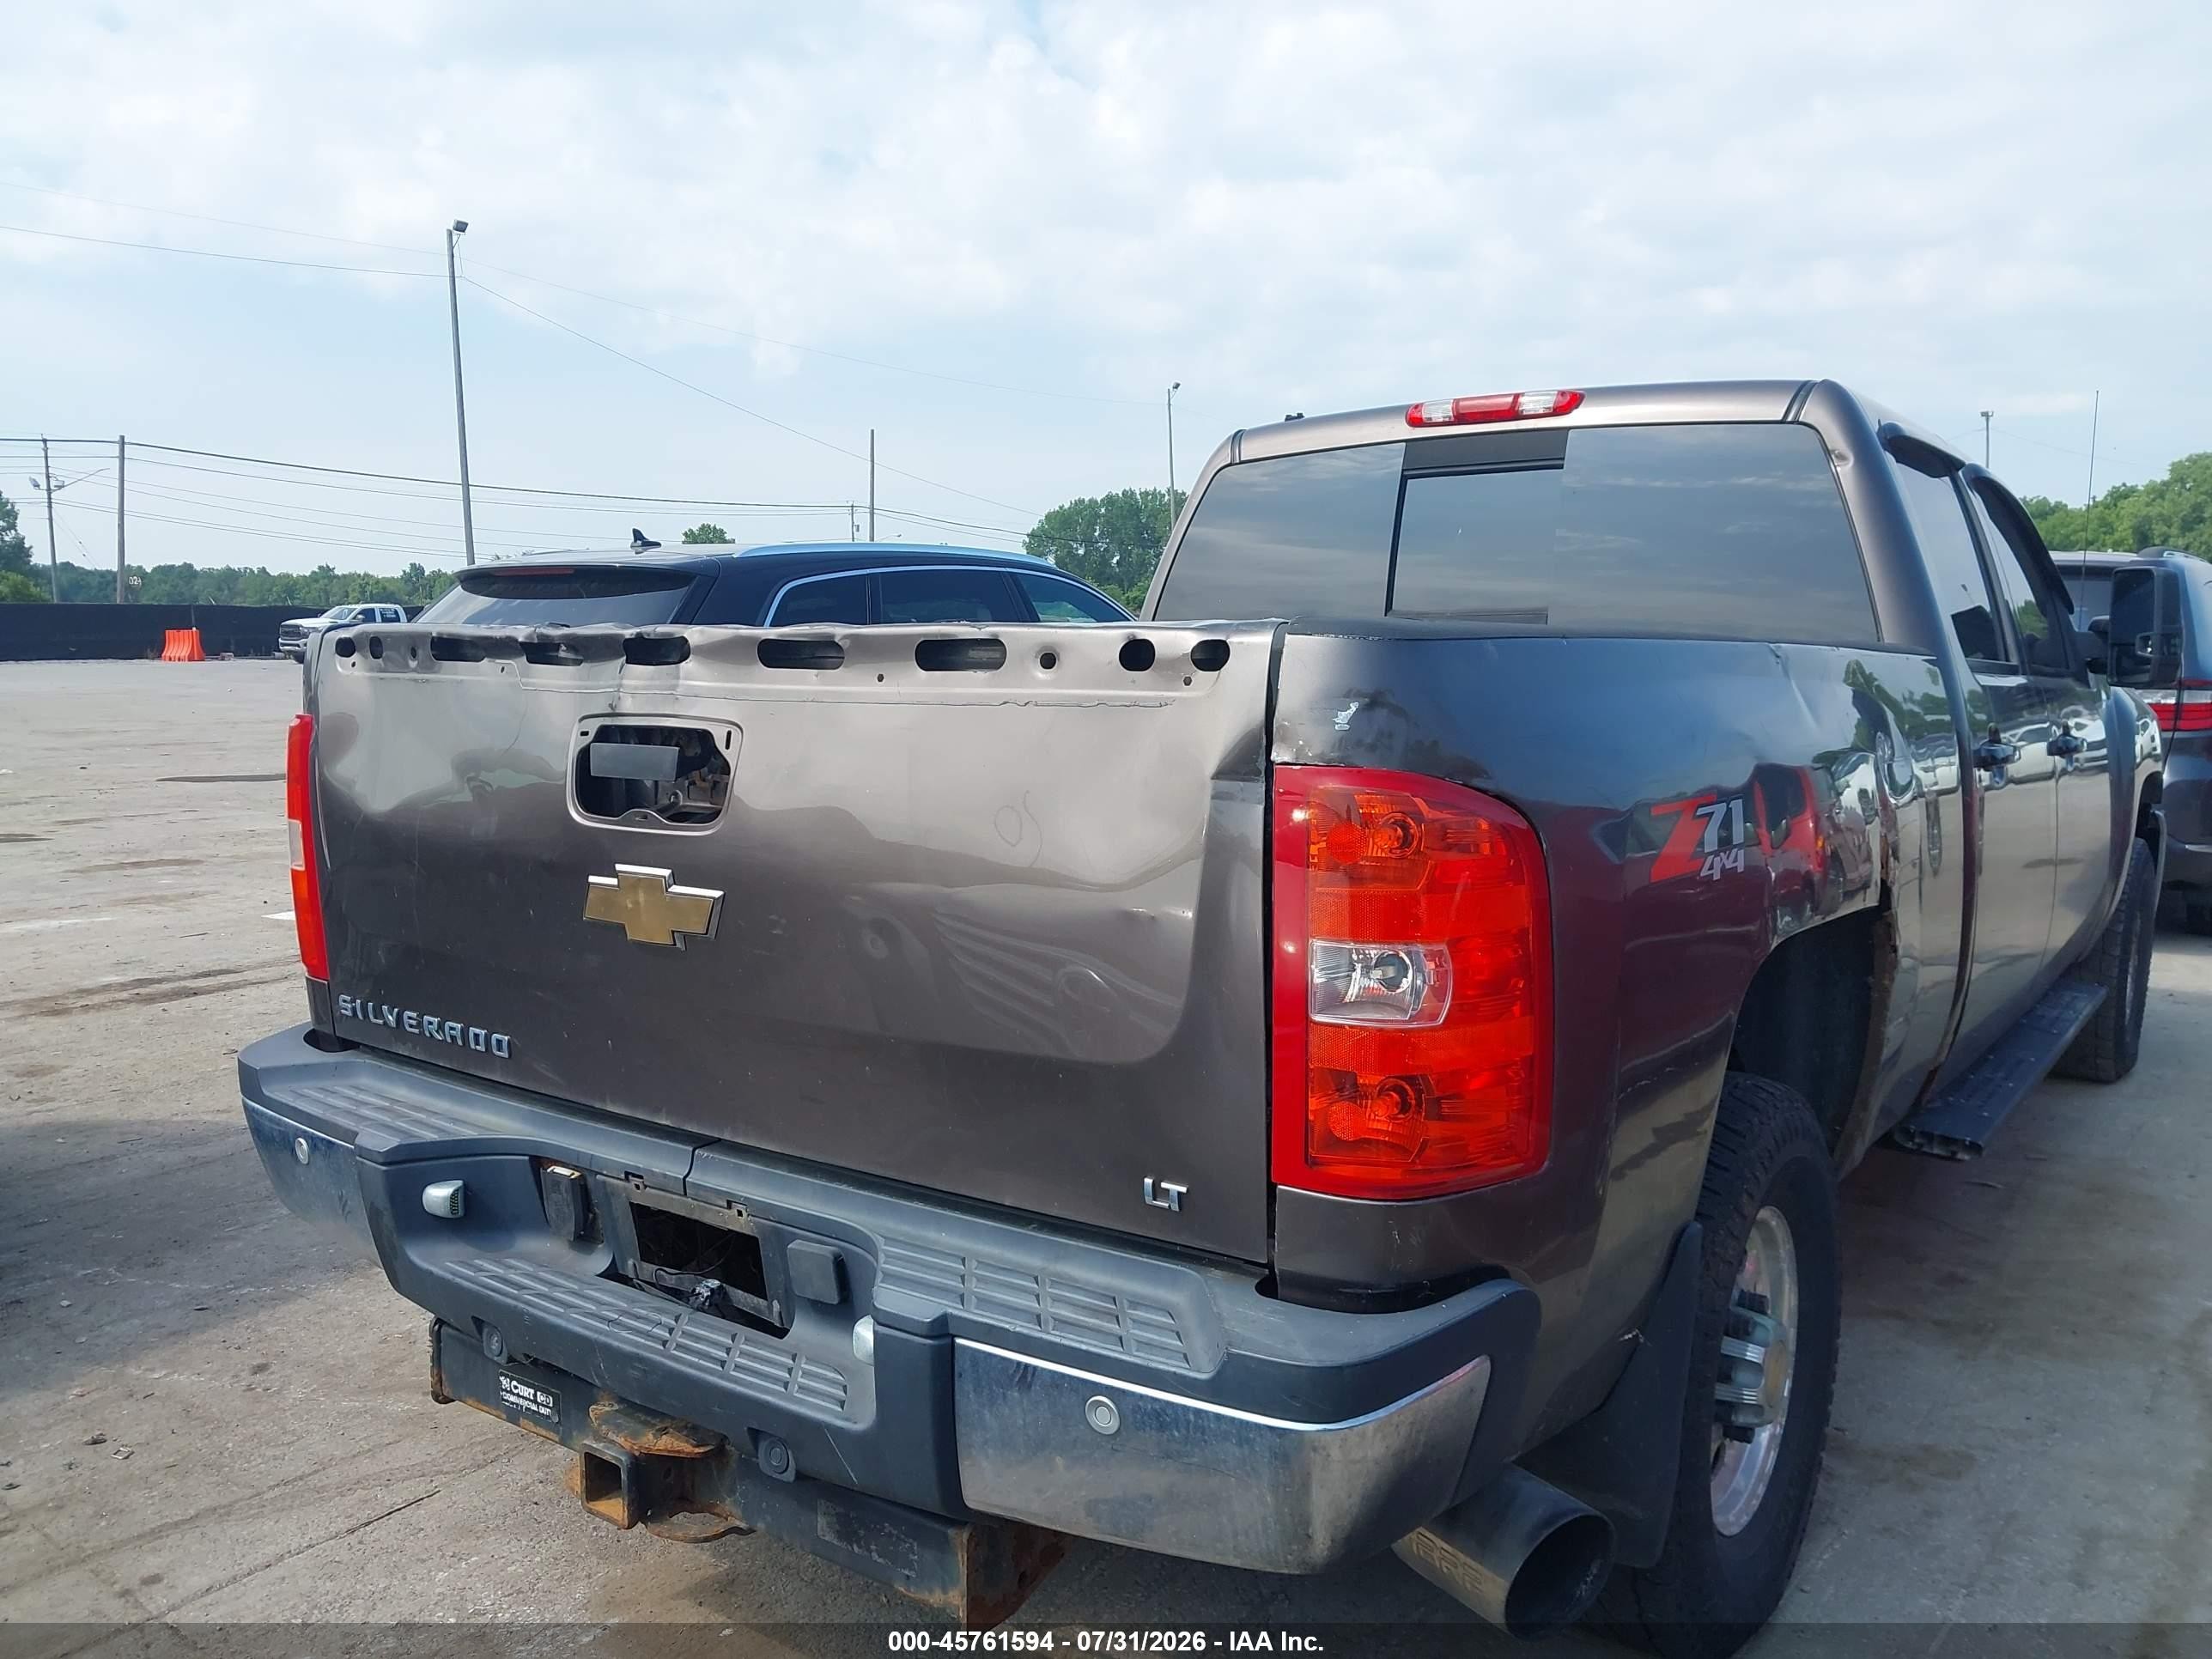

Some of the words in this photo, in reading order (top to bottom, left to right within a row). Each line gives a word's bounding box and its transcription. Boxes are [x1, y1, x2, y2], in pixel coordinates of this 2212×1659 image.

[1650, 793, 1745, 883] Z71
[338, 994, 510, 1059] SILVERADO
[1144, 1176, 1188, 1212] LT
[511, 1380, 535, 1400] CURT
